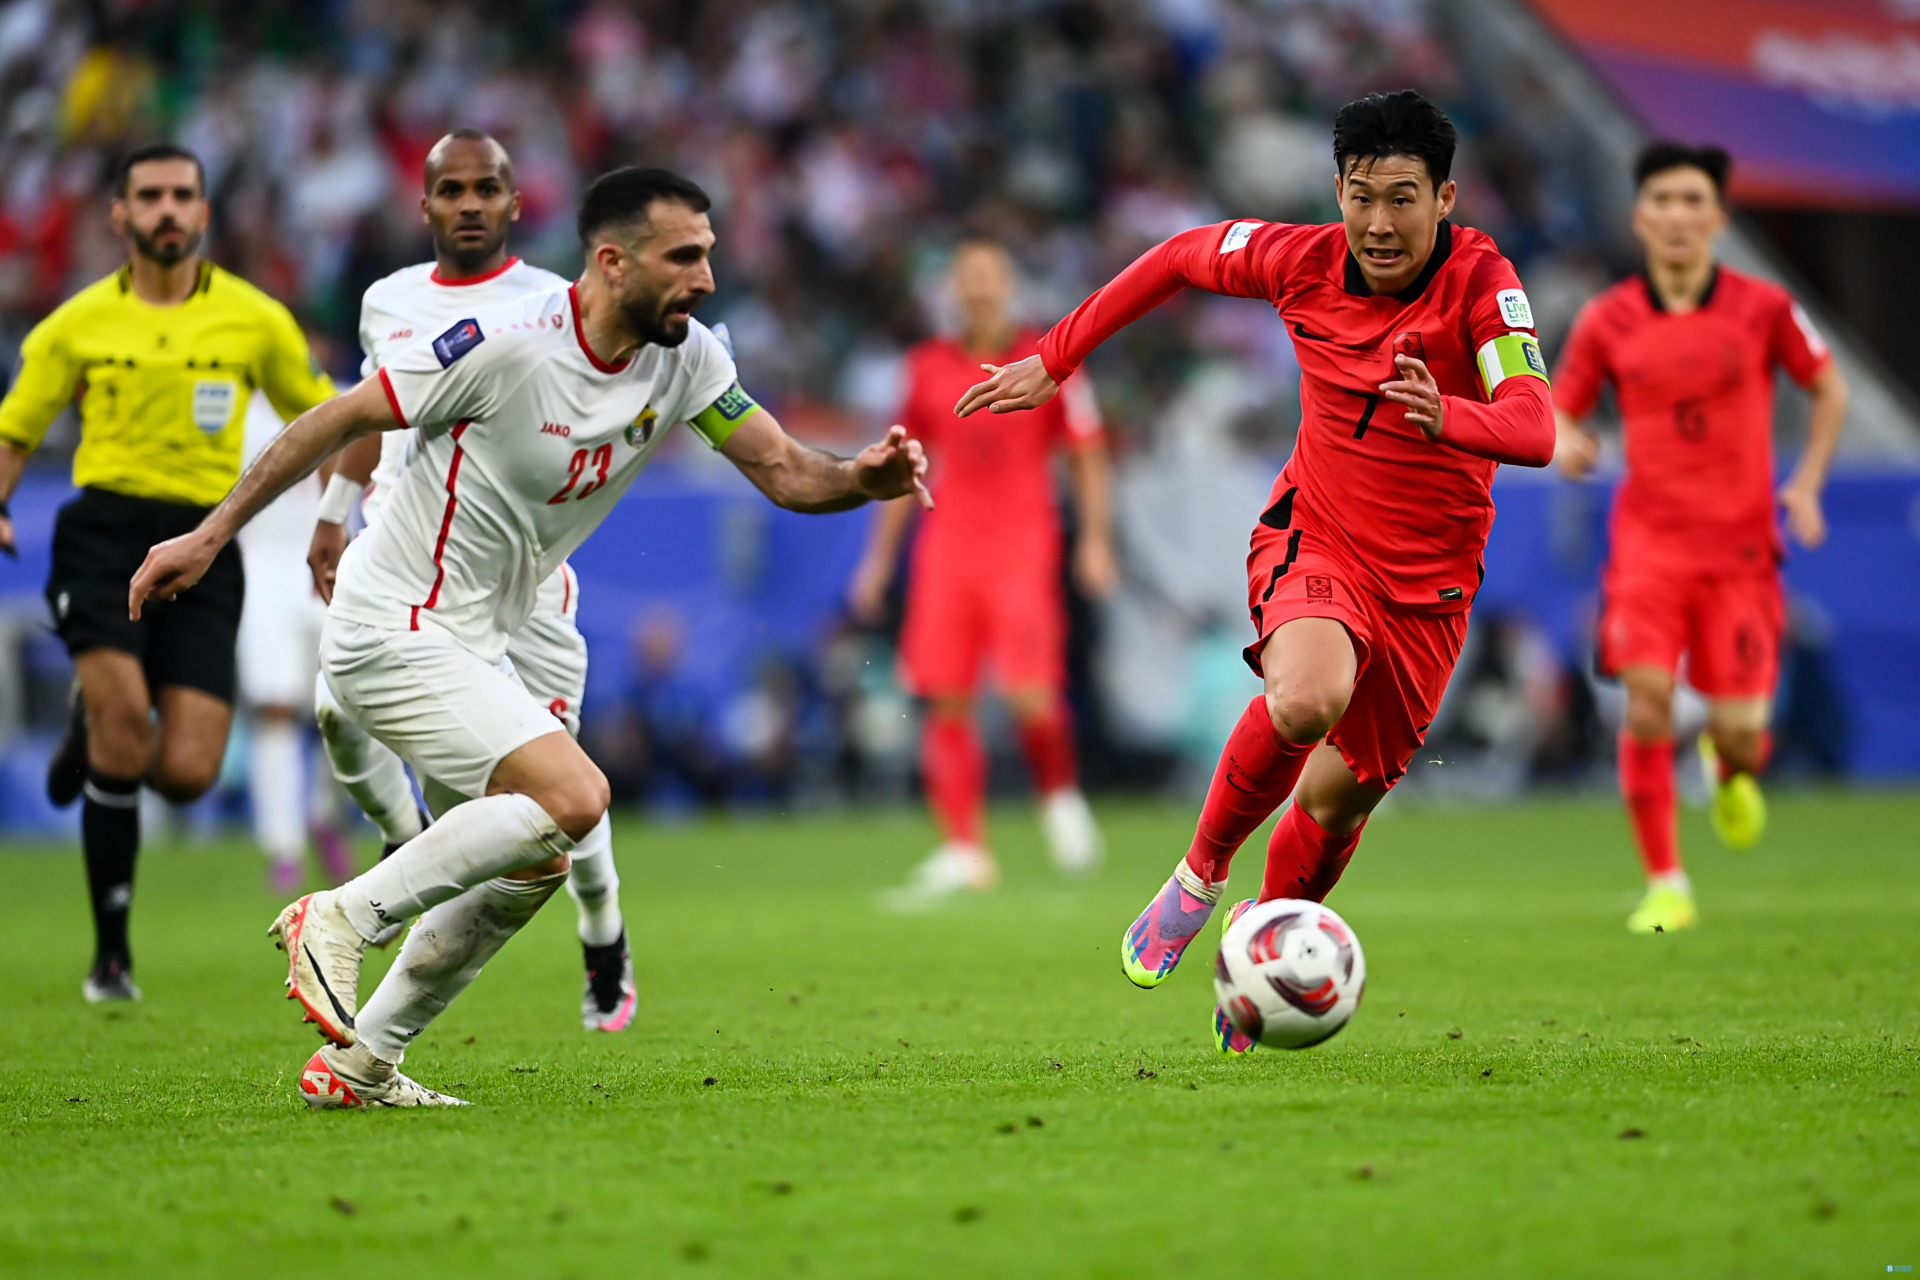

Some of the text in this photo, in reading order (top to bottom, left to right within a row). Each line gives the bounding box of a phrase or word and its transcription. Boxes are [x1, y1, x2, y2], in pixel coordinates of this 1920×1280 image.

[1506, 303, 1529, 314] LIVE
[540, 421, 571, 437] JAKO
[1343, 388, 1379, 440] 7
[1674, 398, 1707, 443] 6
[546, 443, 613, 505] 23
